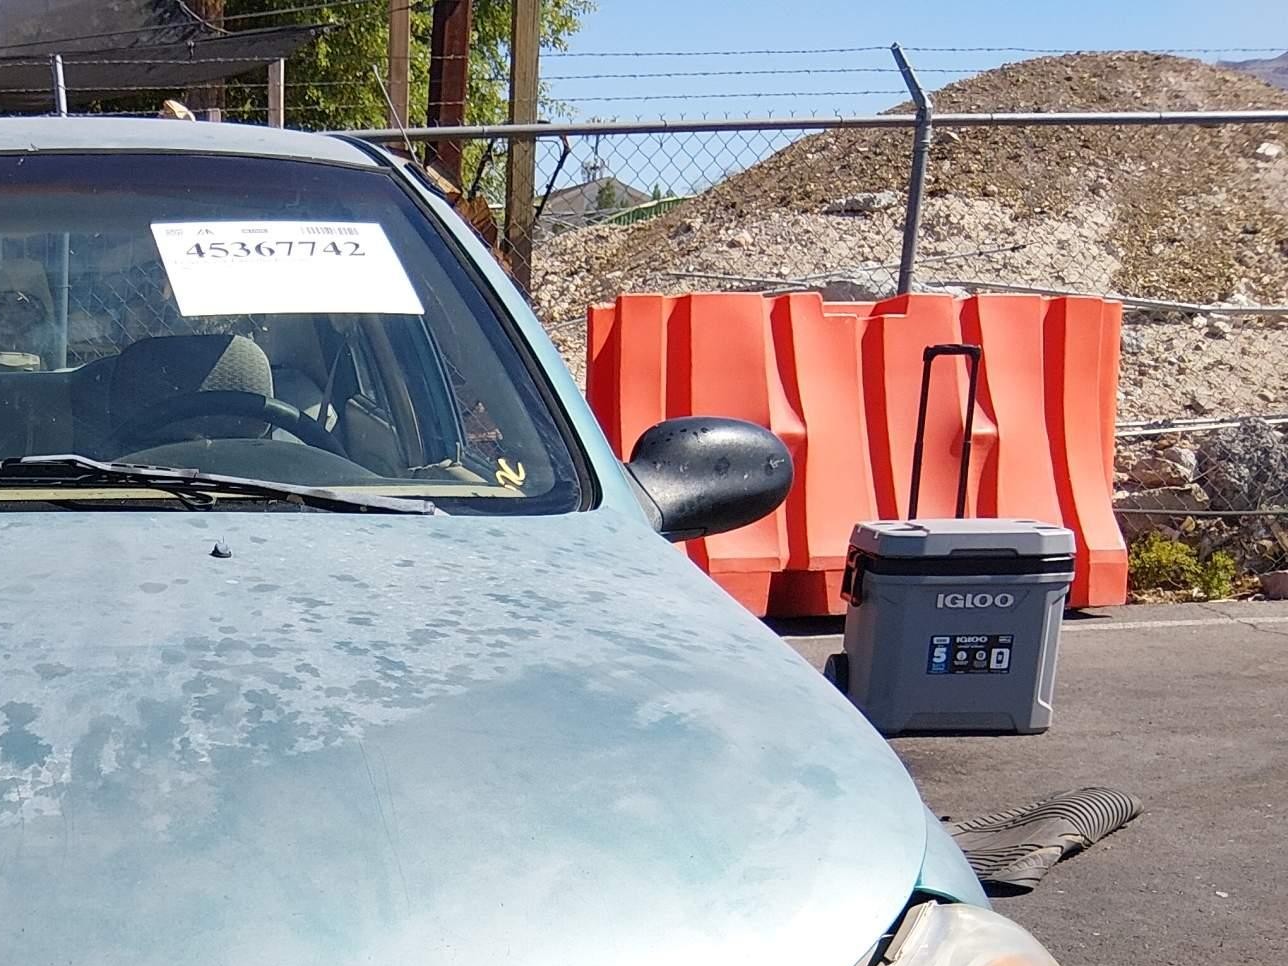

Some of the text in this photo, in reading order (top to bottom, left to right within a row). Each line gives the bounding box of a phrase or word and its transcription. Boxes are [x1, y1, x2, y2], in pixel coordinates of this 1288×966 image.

[185, 241, 366, 258] 45367742
[936, 592, 1014, 609] IGLOO
[956, 635, 988, 644] IGLOO
[932, 647, 947, 663] 5
